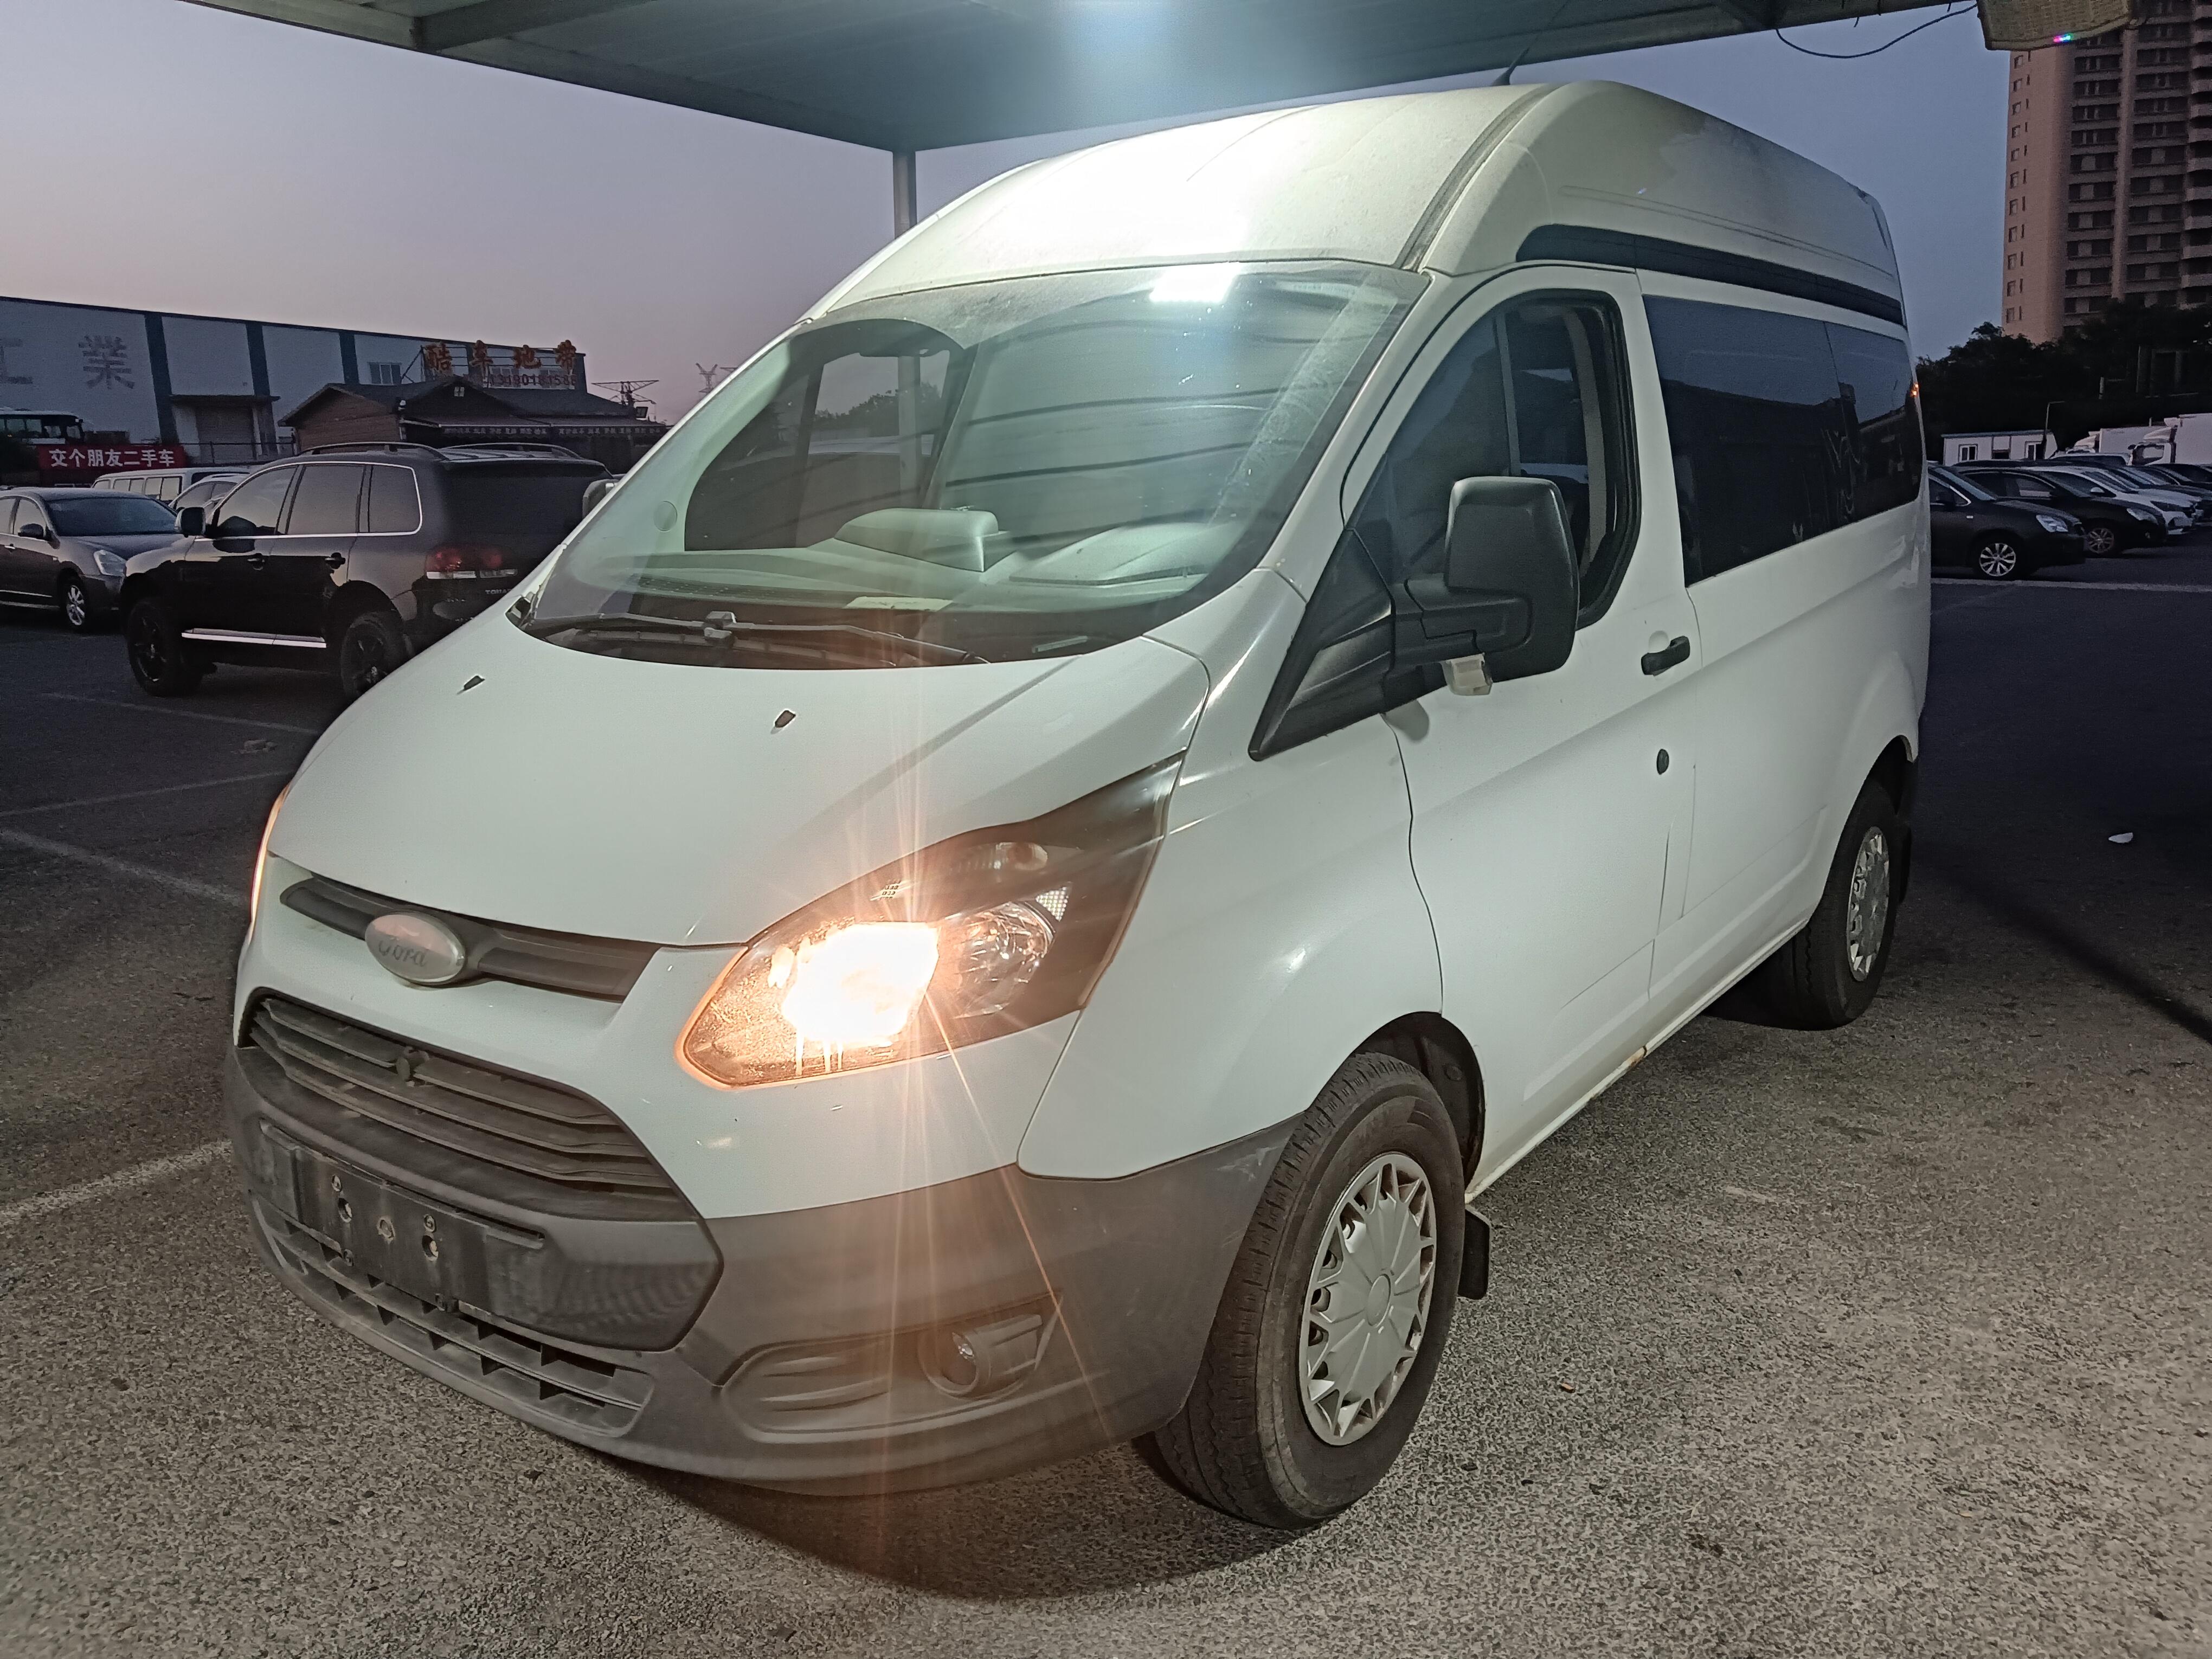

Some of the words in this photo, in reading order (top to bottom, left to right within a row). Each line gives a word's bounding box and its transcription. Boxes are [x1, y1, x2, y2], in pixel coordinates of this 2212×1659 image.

[49, 448, 175, 467] 交个朋友二手车
